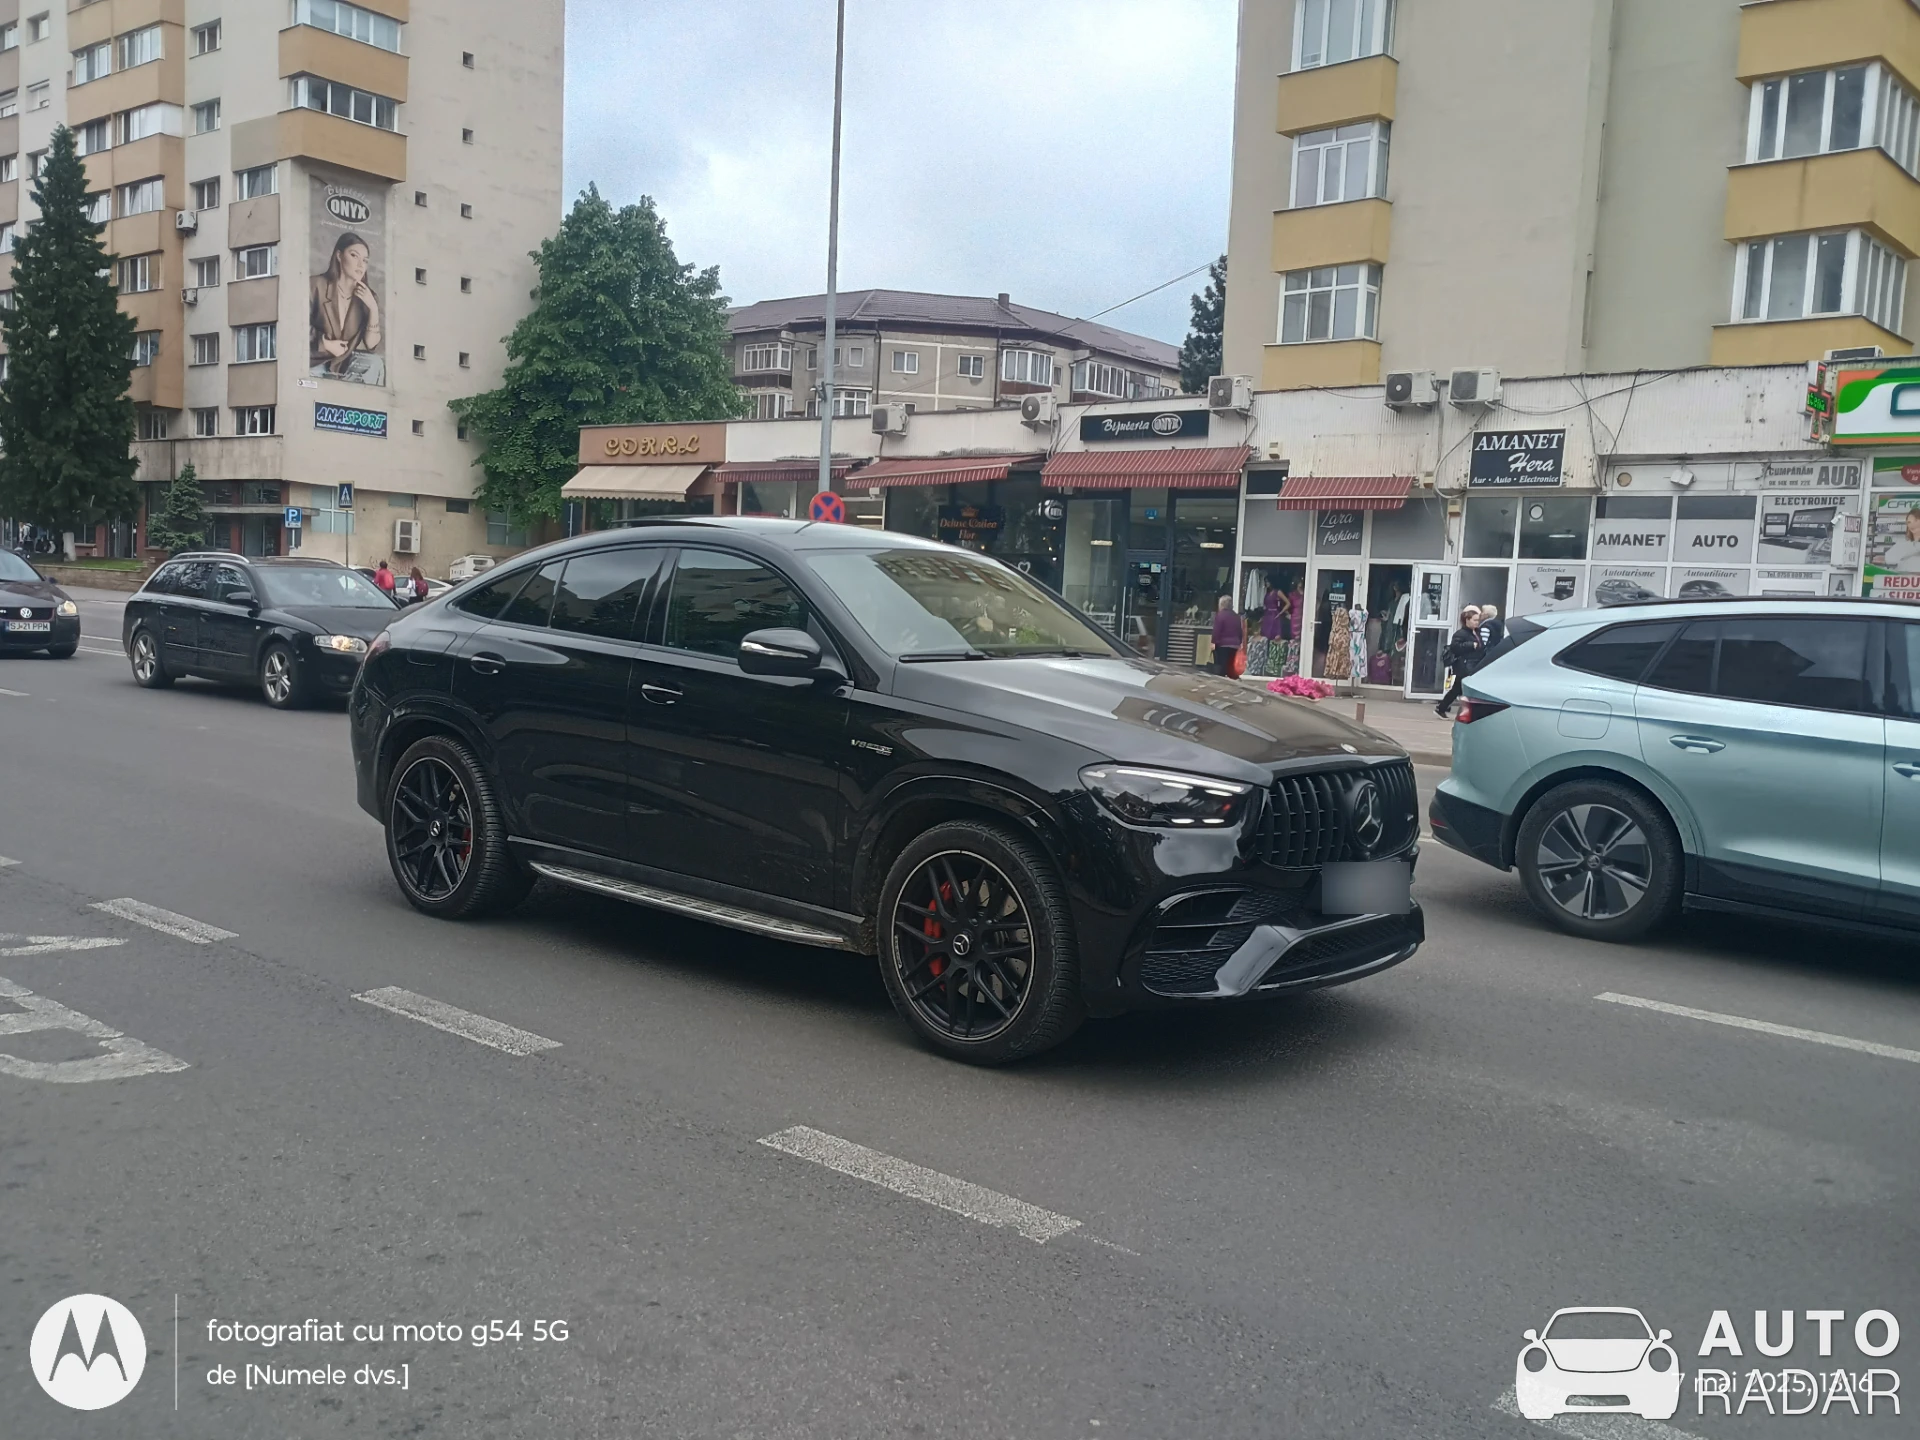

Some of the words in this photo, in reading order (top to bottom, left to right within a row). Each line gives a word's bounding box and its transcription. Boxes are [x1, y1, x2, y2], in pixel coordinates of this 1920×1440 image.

[330, 199, 367, 219] ONYX
[604, 435, 700, 456] CORAL
[1474, 433, 1564, 451] AMANET
[1508, 452, 1555, 472] Hera
[1519, 475, 1559, 483] Electronice
[1816, 465, 1859, 486] AUR
[1774, 497, 1846, 506] ELECTRONICE
[288, 508, 298, 522] P
[1320, 508, 1355, 528] Lara
[1322, 530, 1360, 546] fashion
[1597, 533, 1667, 547] AMANET
[1692, 534, 1739, 548] AUTO
[1601, 568, 1656, 578] Autoturisme
[1684, 569, 1738, 578] Autoutilitare
